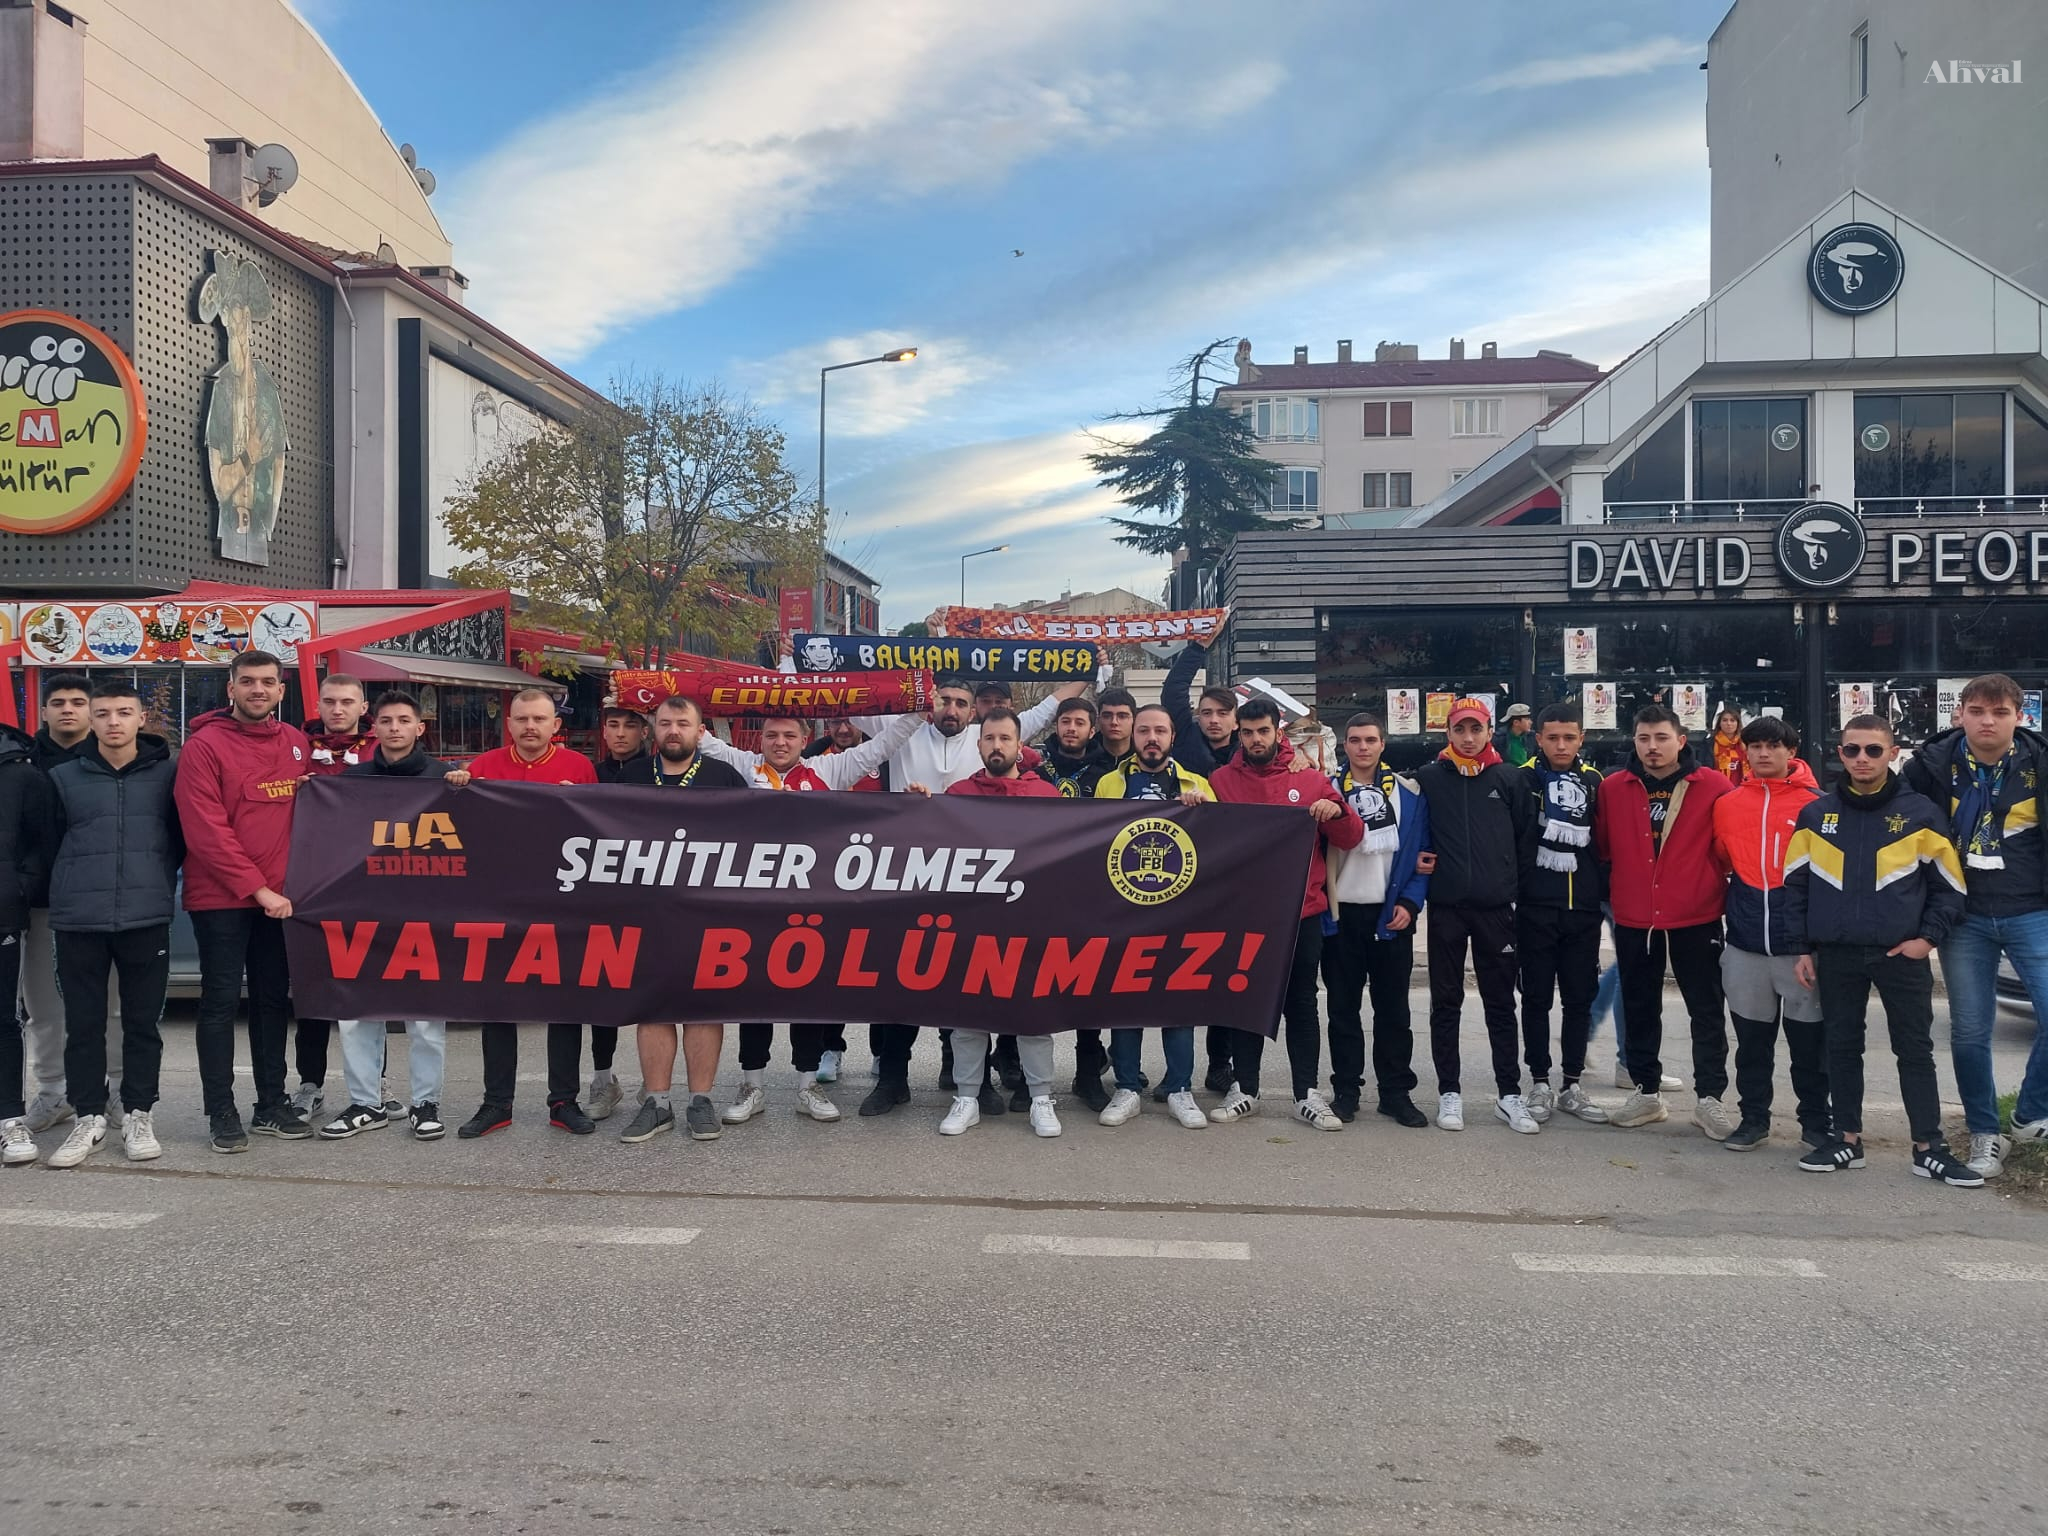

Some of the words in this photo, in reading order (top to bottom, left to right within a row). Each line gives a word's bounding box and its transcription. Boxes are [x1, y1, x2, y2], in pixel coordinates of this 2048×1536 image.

[1570, 537, 1752, 590] DAVID
[1045, 616, 1217, 639] EDİRNE
[859, 644, 960, 672] BALKAN
[970, 648, 1003, 670] OF
[1012, 648, 1092, 673] FENER
[711, 684, 872, 706] EDİRNE
[1939, 692, 1955, 702] 0284
[1128, 820, 1179, 837] EDİRNE
[1821, 824, 1837, 834] SK
[1823, 813, 1839, 823] FB
[366, 850, 467, 876] EDİRNE
[556, 828, 816, 892] ŞEHİTLER
[834, 833, 1026, 903] ÖLMEZ,
[1141, 857, 1162, 869] FB
[320, 920, 643, 990] VATAN
[693, 913, 1265, 999] BÖLÜNMEZ!
